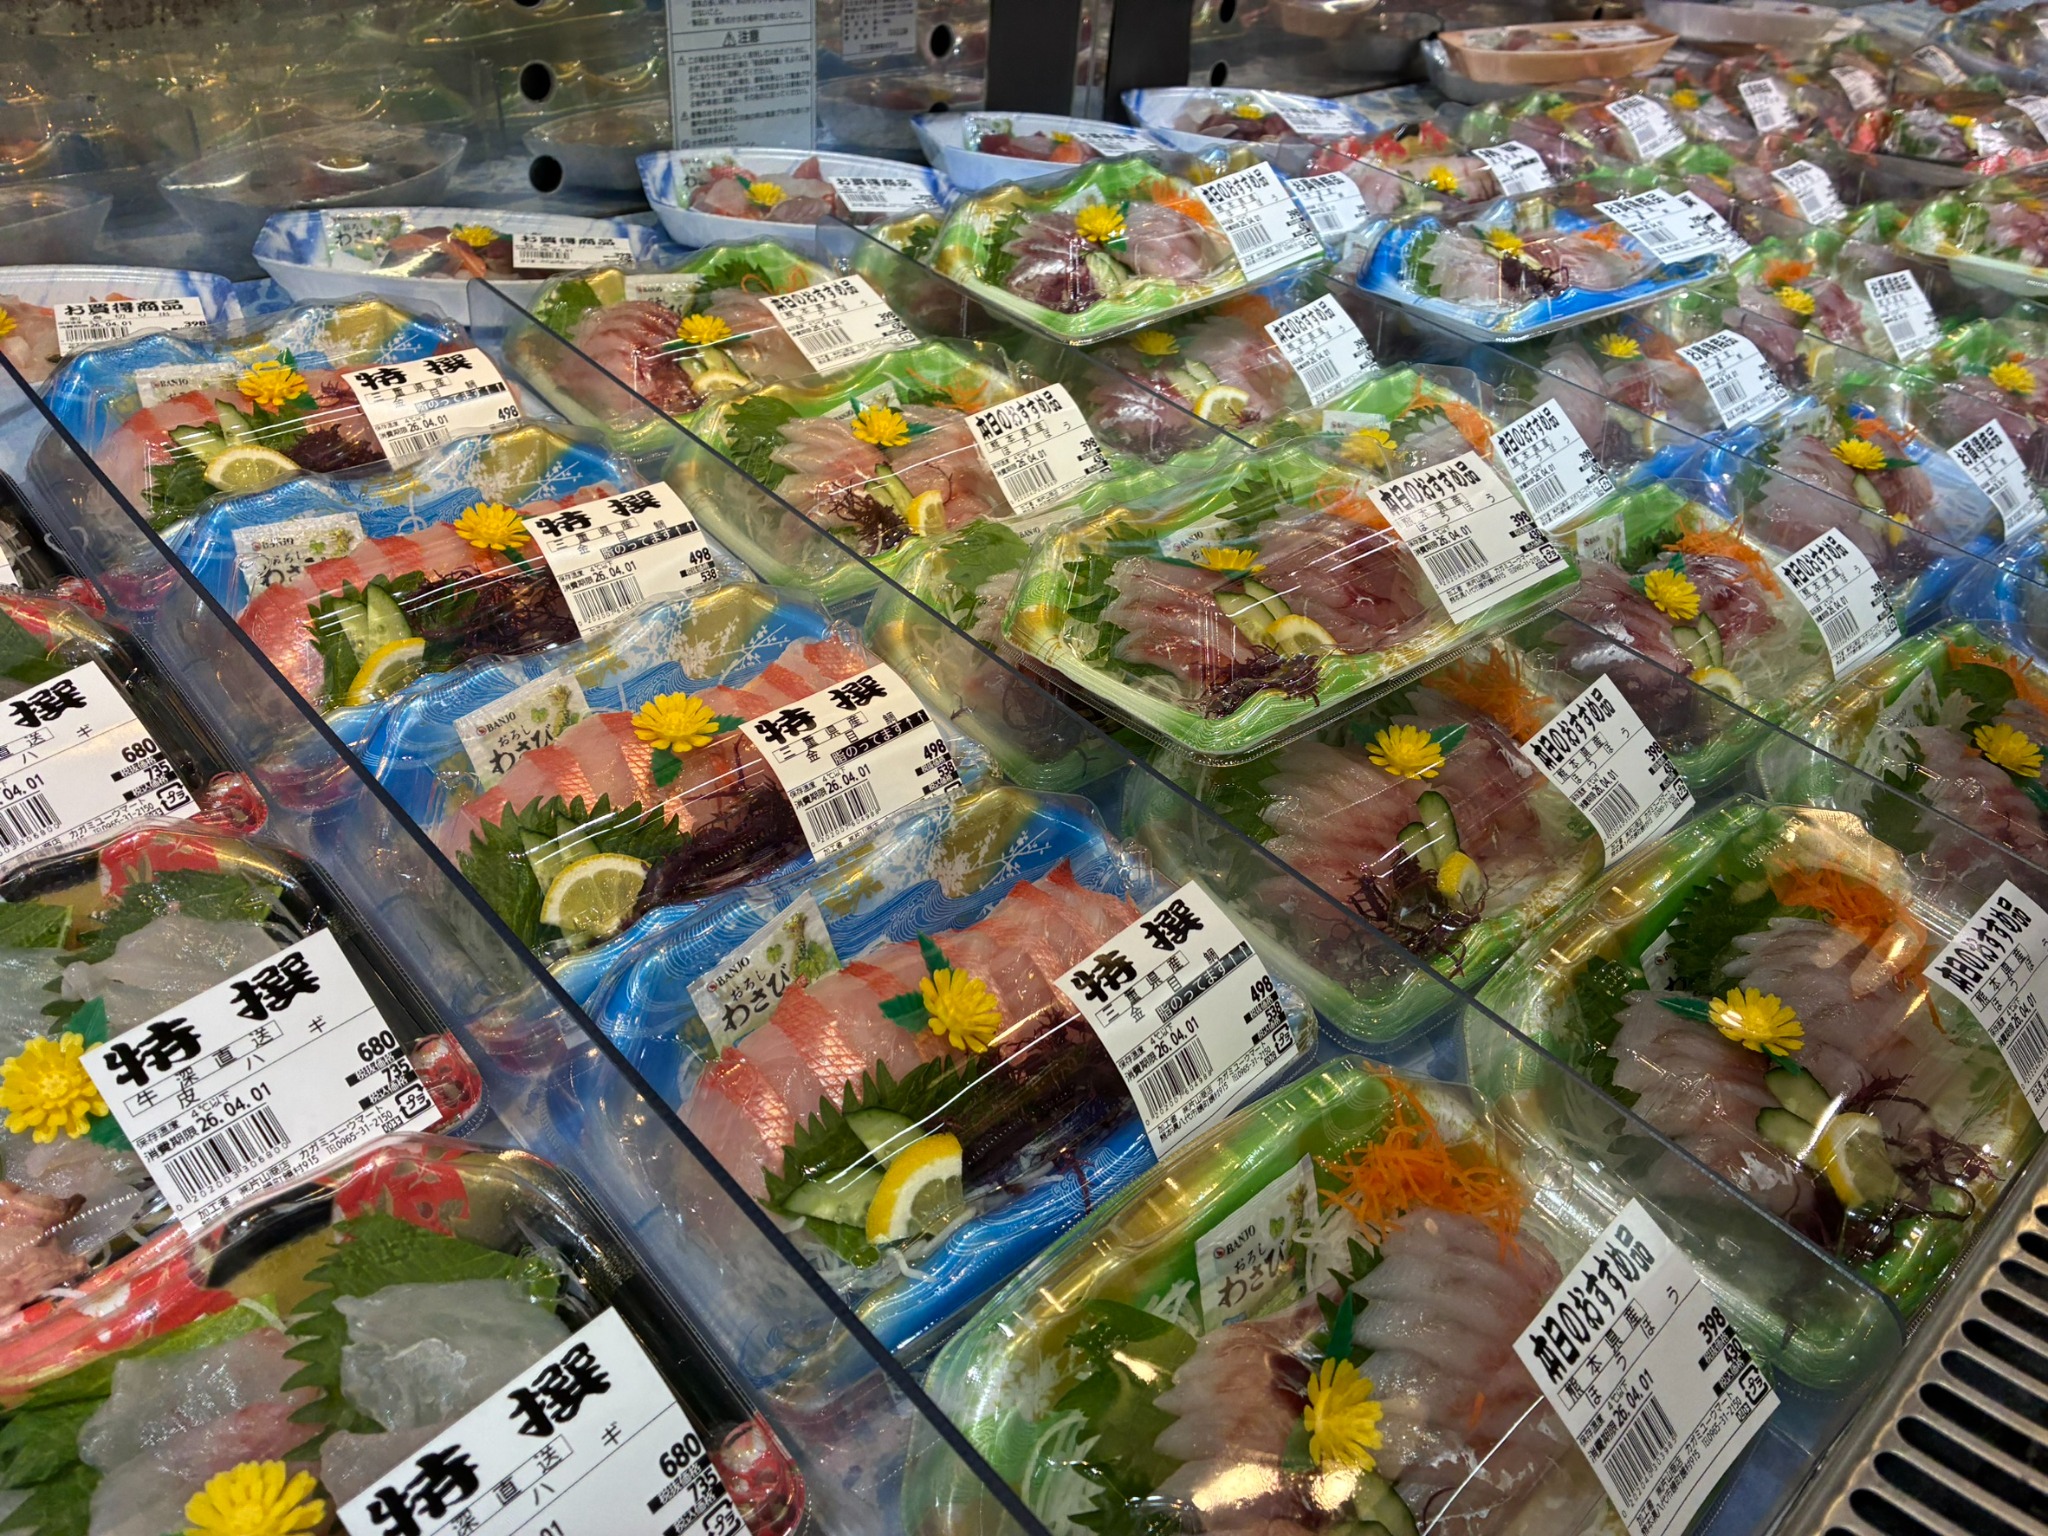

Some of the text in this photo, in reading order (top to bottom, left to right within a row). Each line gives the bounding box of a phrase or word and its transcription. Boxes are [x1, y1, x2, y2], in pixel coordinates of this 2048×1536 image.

[1201, 168, 1270, 205] 本日のおすすめ品
[64, 299, 183, 315] お買得商品
[770, 279, 859, 311] 本日のおすすめ品
[1272, 301, 1336, 343] 本日のおすすめ品
[354, 353, 473, 390] 特撰
[407, 414, 449, 433] 26.04.01
[498, 405, 519, 421] 498
[976, 390, 1063, 440] 本日のおすすめ品
[1080, 436, 1097, 451] 398
[1497, 406, 1560, 458] 本日のおすすめ品
[1379, 461, 1481, 516] 本日のおすすめ品
[535, 490, 661, 537] 特撰
[1510, 511, 1532, 528] 398
[553, 519, 634, 551] 三重県産
[601, 530, 672, 560] 脂のってます
[1180, 530, 1204, 548] BANJO
[1437, 524, 1472, 546] 26.04.01
[1528, 528, 1544, 541] 430
[594, 560, 637, 582] 26.04.01
[689, 547, 712, 565] 498
[1781, 535, 1849, 589] 本日のおすすめ品
[700, 569, 717, 584] 538
[486, 712, 516, 733] BANJO
[755, 675, 888, 745] 特撰
[1529, 687, 1615, 770] 本日のおすすめ品
[121, 737, 158, 763] 680
[497, 725, 531, 748] おろし
[780, 714, 864, 761] 三重県産
[806, 712, 899, 763] 金目鯛
[831, 723, 903, 766] 脂のってます
[923, 739, 946, 760] 498
[1644, 741, 1663, 762] 398
[144, 761, 171, 782] 735
[825, 763, 871, 794] 26.04.01
[937, 762, 955, 779] 538
[1591, 769, 1619, 796] 26.04.01
[1071, 899, 1204, 1002] 特撰
[1935, 896, 2031, 995] 本日のおすすめ品
[716, 956, 750, 987] BANJO
[731, 971, 766, 1001] おろし
[1104, 956, 1184, 1022] 三重県産
[1129, 948, 1220, 1023] 金目鯛
[1156, 958, 1227, 1022] 脂のってます
[1250, 975, 1273, 1003] 498
[721, 963, 791, 1033] わさび
[1265, 1001, 1282, 1022] 538
[2013, 992, 2037, 1033] 26.04.01
[103, 951, 321, 1087] 特撰
[179, 1015, 327, 1110] 皮ハギ
[356, 1030, 396, 1063] 680
[1126, 1015, 1200, 1083] 消費期限 26.04.01
[1217, 1041, 1267, 1086] カガミユーウマート
[137, 1027, 274, 1108] 牛深直送
[381, 1060, 410, 1084] 735
[136, 1093, 230, 1149] 保存温度 4℃以下
[144, 1082, 272, 1163] 消費期限 26.04.01
[300, 1105, 384, 1160] カガミユーウマート
[1226, 1224, 1256, 1256] BANJO
[1234, 1242, 1267, 1274] おろし
[1218, 1239, 1286, 1308] わさび
[1530, 1223, 1655, 1385] 本日のおすすめ品
[1698, 1306, 1727, 1343] 398
[1566, 1306, 1645, 1405] 熊本県産
[1586, 1286, 1680, 1407] ほうぼう
[1723, 1338, 1744, 1367] 430
[1589, 1369, 1654, 1464] 消費期限 26.04.01
[1686, 1391, 1733, 1456] カガミユーウマート
[366, 1342, 612, 1536] 特撰
[659, 1432, 701, 1479] 680
[686, 1467, 718, 1501] 735
